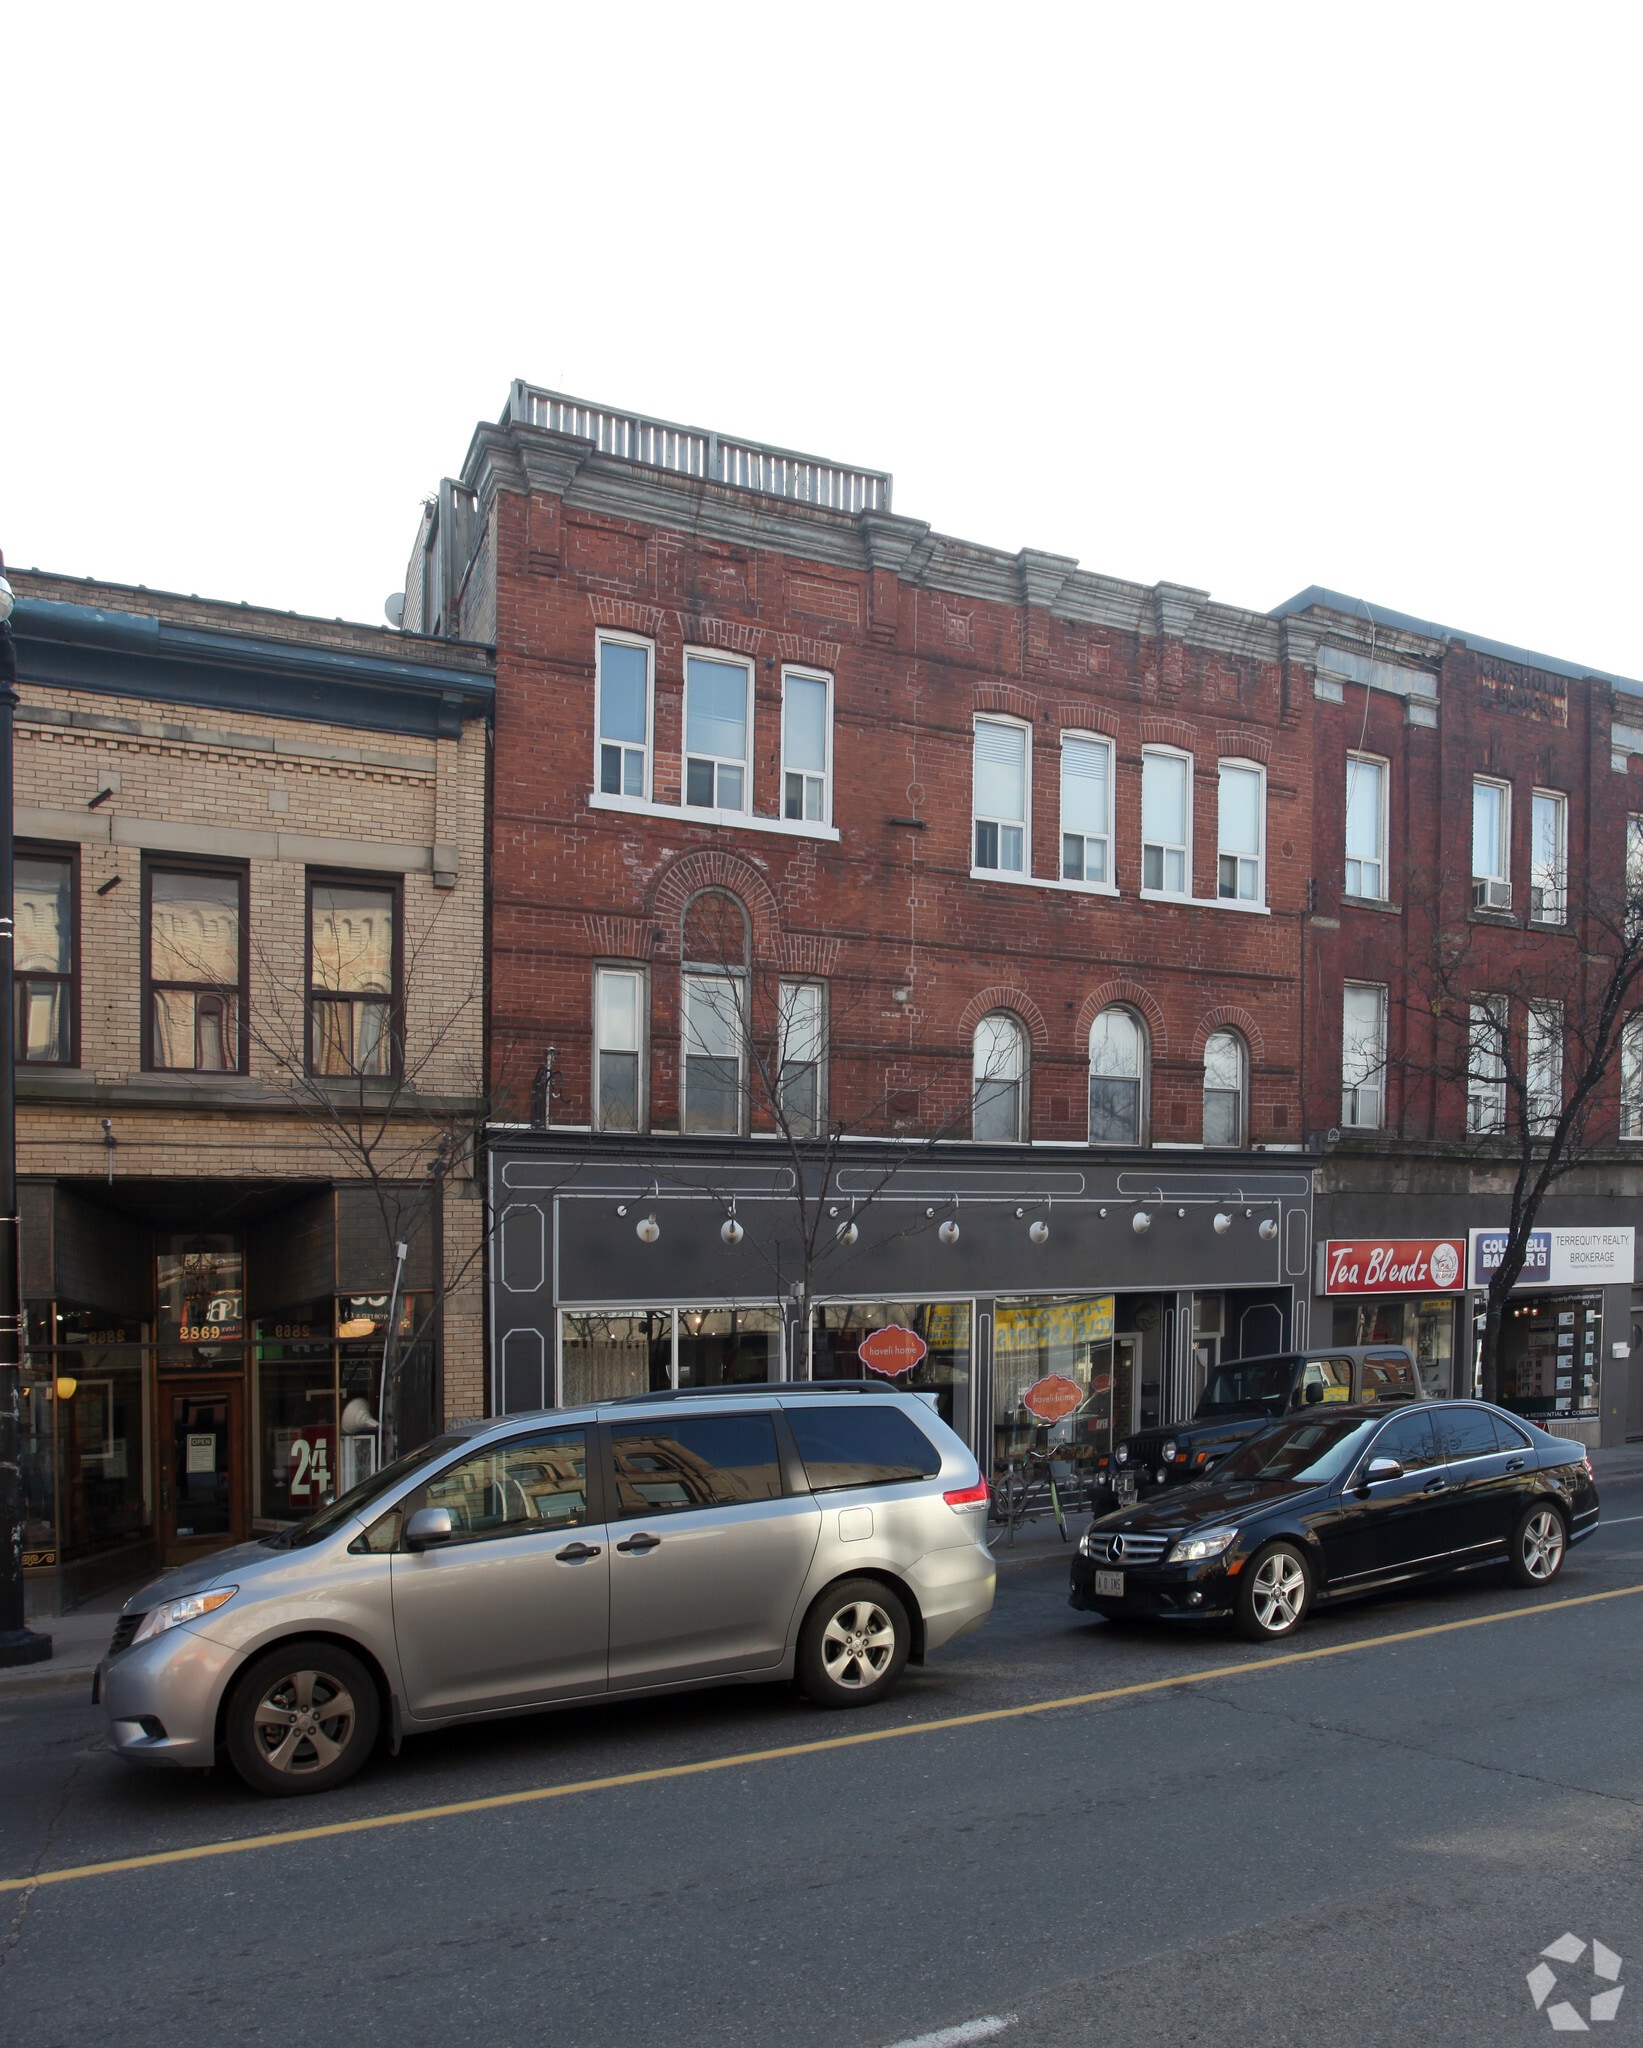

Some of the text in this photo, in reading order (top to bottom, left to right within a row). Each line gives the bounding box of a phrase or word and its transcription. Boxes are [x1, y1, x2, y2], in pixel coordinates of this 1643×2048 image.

[1482, 1239, 1547, 1252] COLELL
[1555, 1235, 1602, 1246] TERREQUITY
[1570, 1252, 1614, 1263] BROKERAGE
[1330, 1247, 1428, 1286] Tea Blendz
[180, 1326, 221, 1340] 2869
[869, 1345, 917, 1355] haveli home
[1033, 1393, 1075, 1404] haveli home
[1096, 1418, 1109, 1430] OPEN
[290, 1438, 331, 1495] 24
